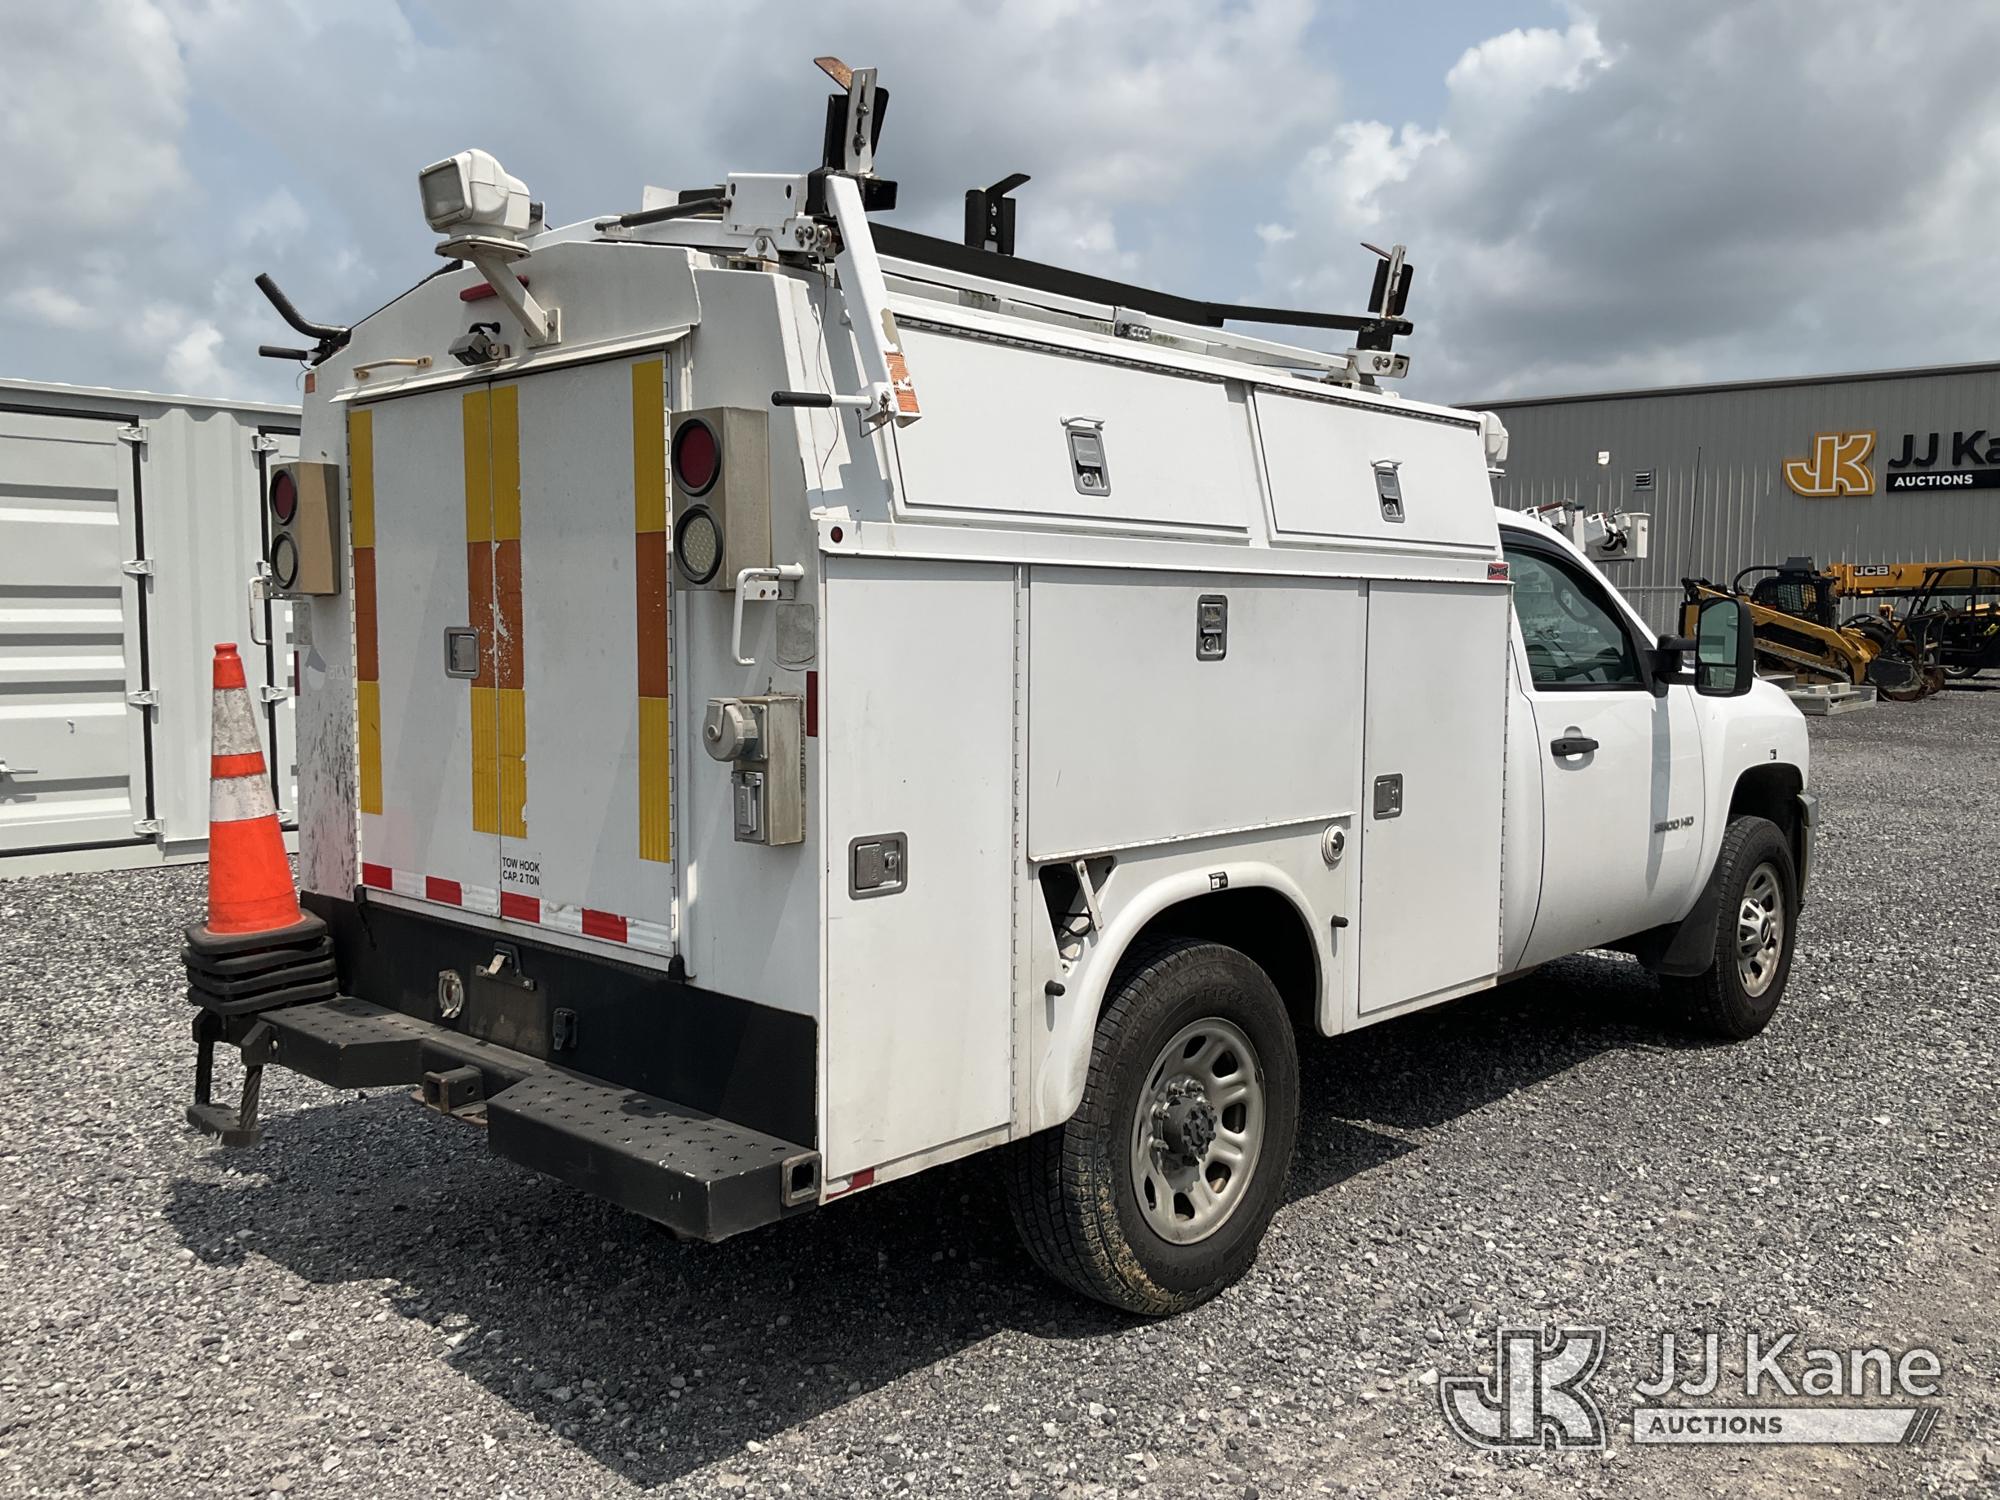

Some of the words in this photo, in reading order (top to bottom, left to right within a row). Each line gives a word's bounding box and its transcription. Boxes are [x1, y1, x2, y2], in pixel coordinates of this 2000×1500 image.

[1888, 433, 1939, 468] JJ
[1783, 432, 1875, 496] JK
[1894, 474, 1973, 487] AUCTIONS
[1854, 566, 1889, 576] JCB
[502, 857, 518, 869] TOW
[519, 860, 540, 873] HOOK
[502, 870, 519, 882] CAP.
[519, 872, 524, 883] 2
[525, 873, 540, 886] TON
